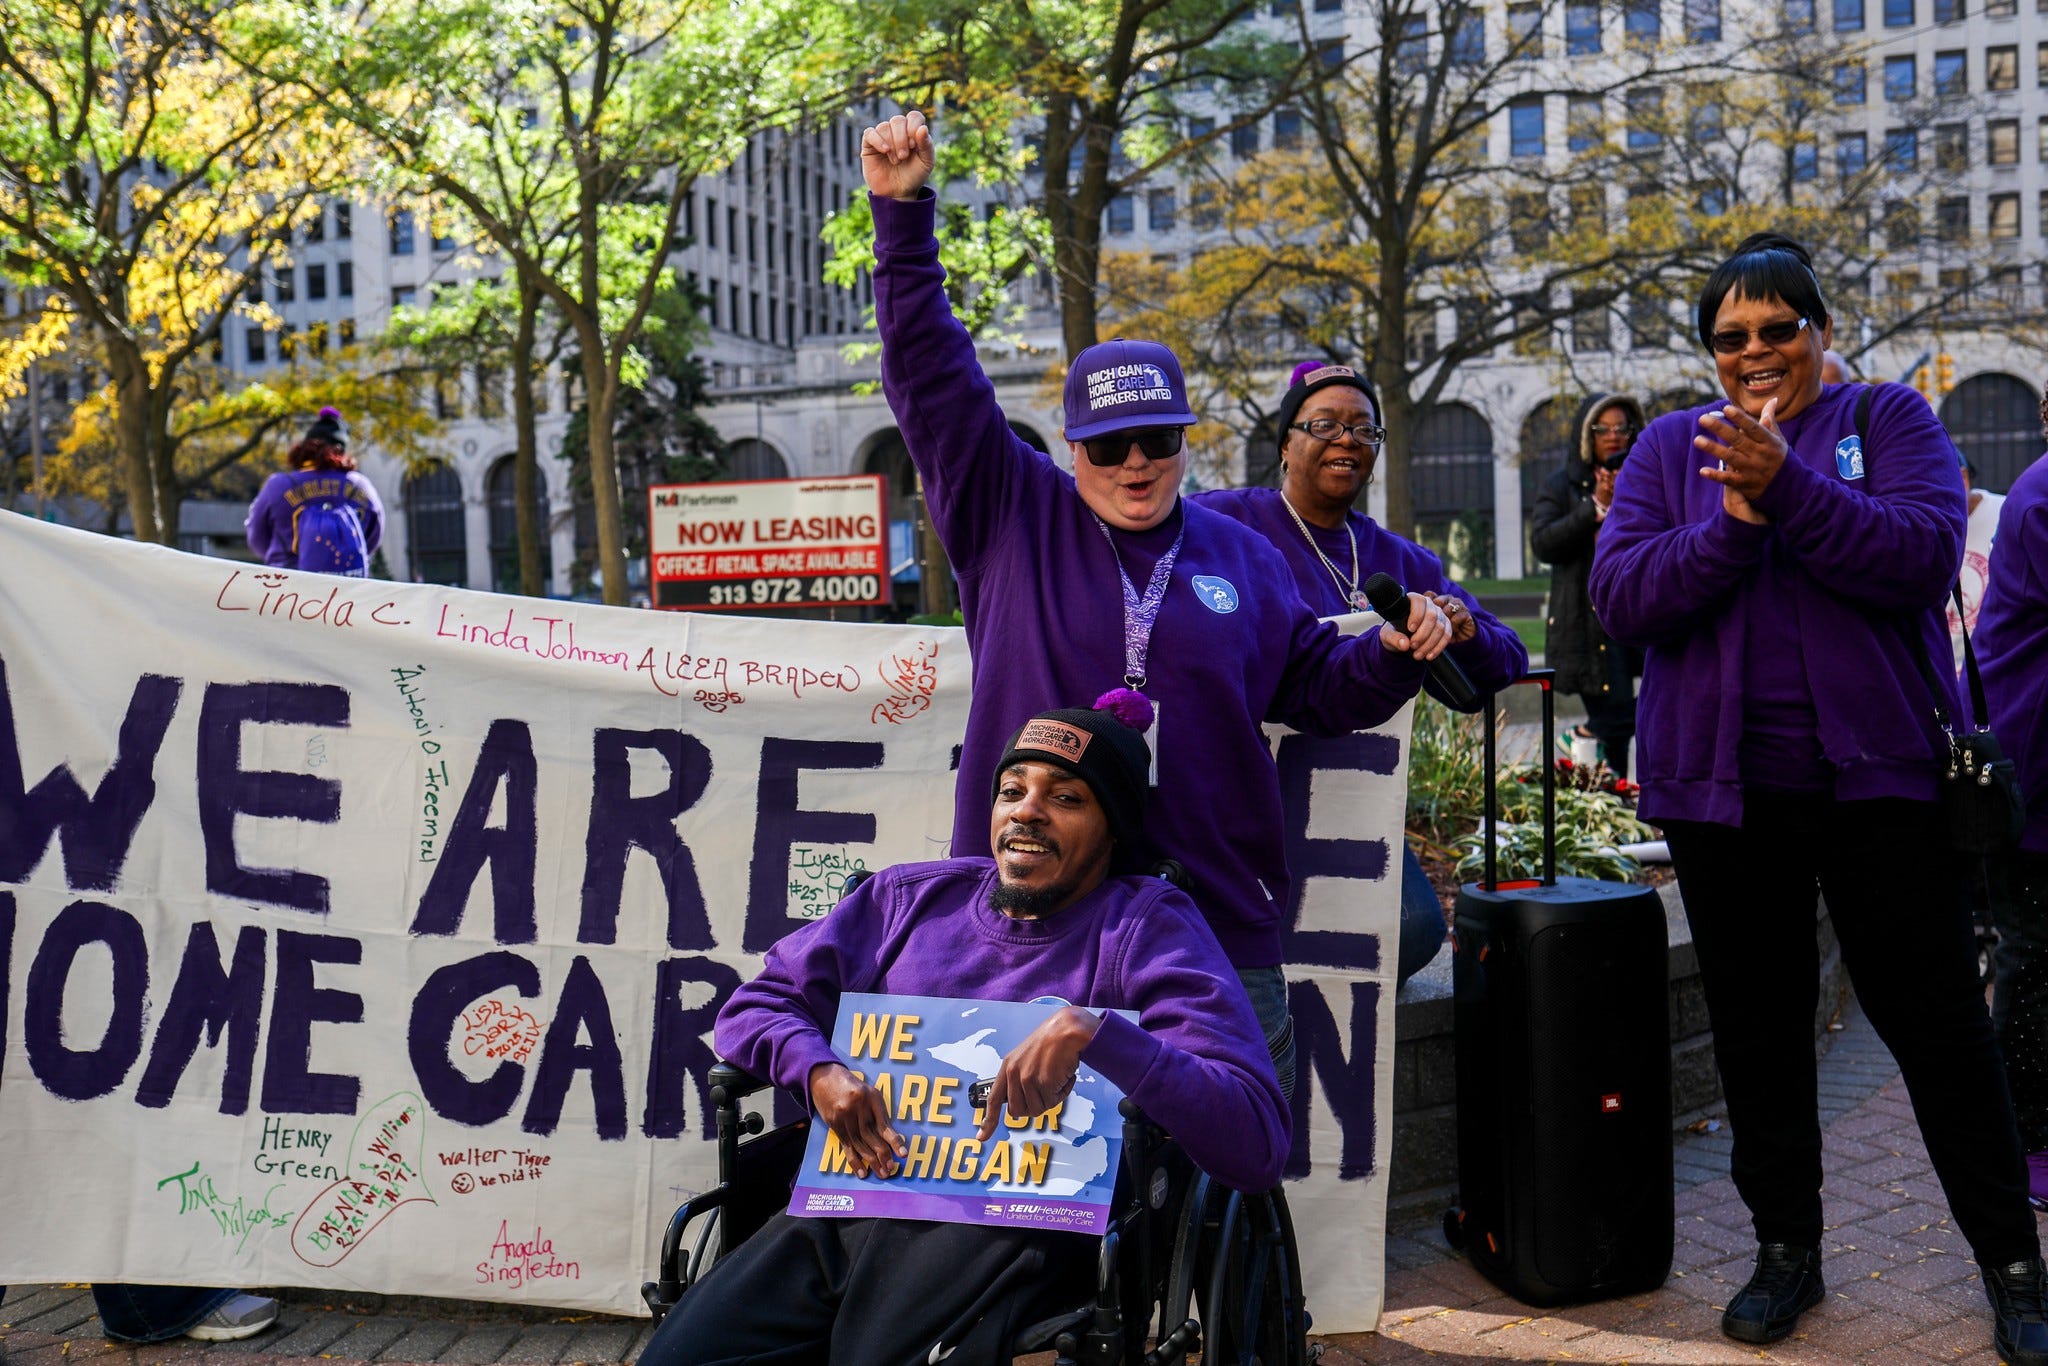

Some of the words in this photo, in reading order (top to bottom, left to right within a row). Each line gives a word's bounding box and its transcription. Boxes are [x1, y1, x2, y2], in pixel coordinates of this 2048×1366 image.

[1087, 364, 1143, 386] MICHIGAN
[1088, 381, 1116, 399] HOME
[1117, 376, 1145, 390] CARE
[1090, 390, 1139, 410] WORKERS
[1140, 388, 1172, 400] UNITED
[678, 521, 744, 544] NOW
[753, 515, 876, 543] LEASING
[657, 556, 707, 576] OFFICE
[715, 556, 760, 574] RETAIL
[762, 554, 804, 572] SPACE
[807, 551, 877, 570] AVAILABLE
[216, 570, 354, 627] Linda
[709, 584, 747, 604] 313
[751, 578, 802, 603] 972
[809, 575, 879, 601] 4000
[437, 603, 529, 653] Linda
[533, 617, 630, 672] Johnson
[1025, 730, 1044, 738] HOME
[1044, 731, 1064, 741] CARE
[1030, 724, 1066, 735] MICHIGAN
[1022, 737, 1054, 747] WORKERS
[1054, 741, 1079, 755] UNITED
[0, 650, 353, 917] WE
[405, 717, 889, 956] ARE
[405, 949, 800, 1142] CAR
[850, 1013, 920, 1061] WE
[848, 1070, 960, 1124] ARE
[260, 1117, 332, 1157] HENRY
[254, 1154, 339, 1181] Green
[819, 1129, 1051, 1185] MHIGAN
[362, 1184, 382, 1204] WE
[376, 1152, 402, 1182] DID
[809, 1193, 843, 1201] MICHIGAN
[1006, 1212, 1031, 1220] United
[1034, 1213, 1044, 1221] for
[1046, 1214, 1073, 1225] Quality
[1075, 1218, 1094, 1227] Care
[476, 1256, 580, 1290] Singleton
